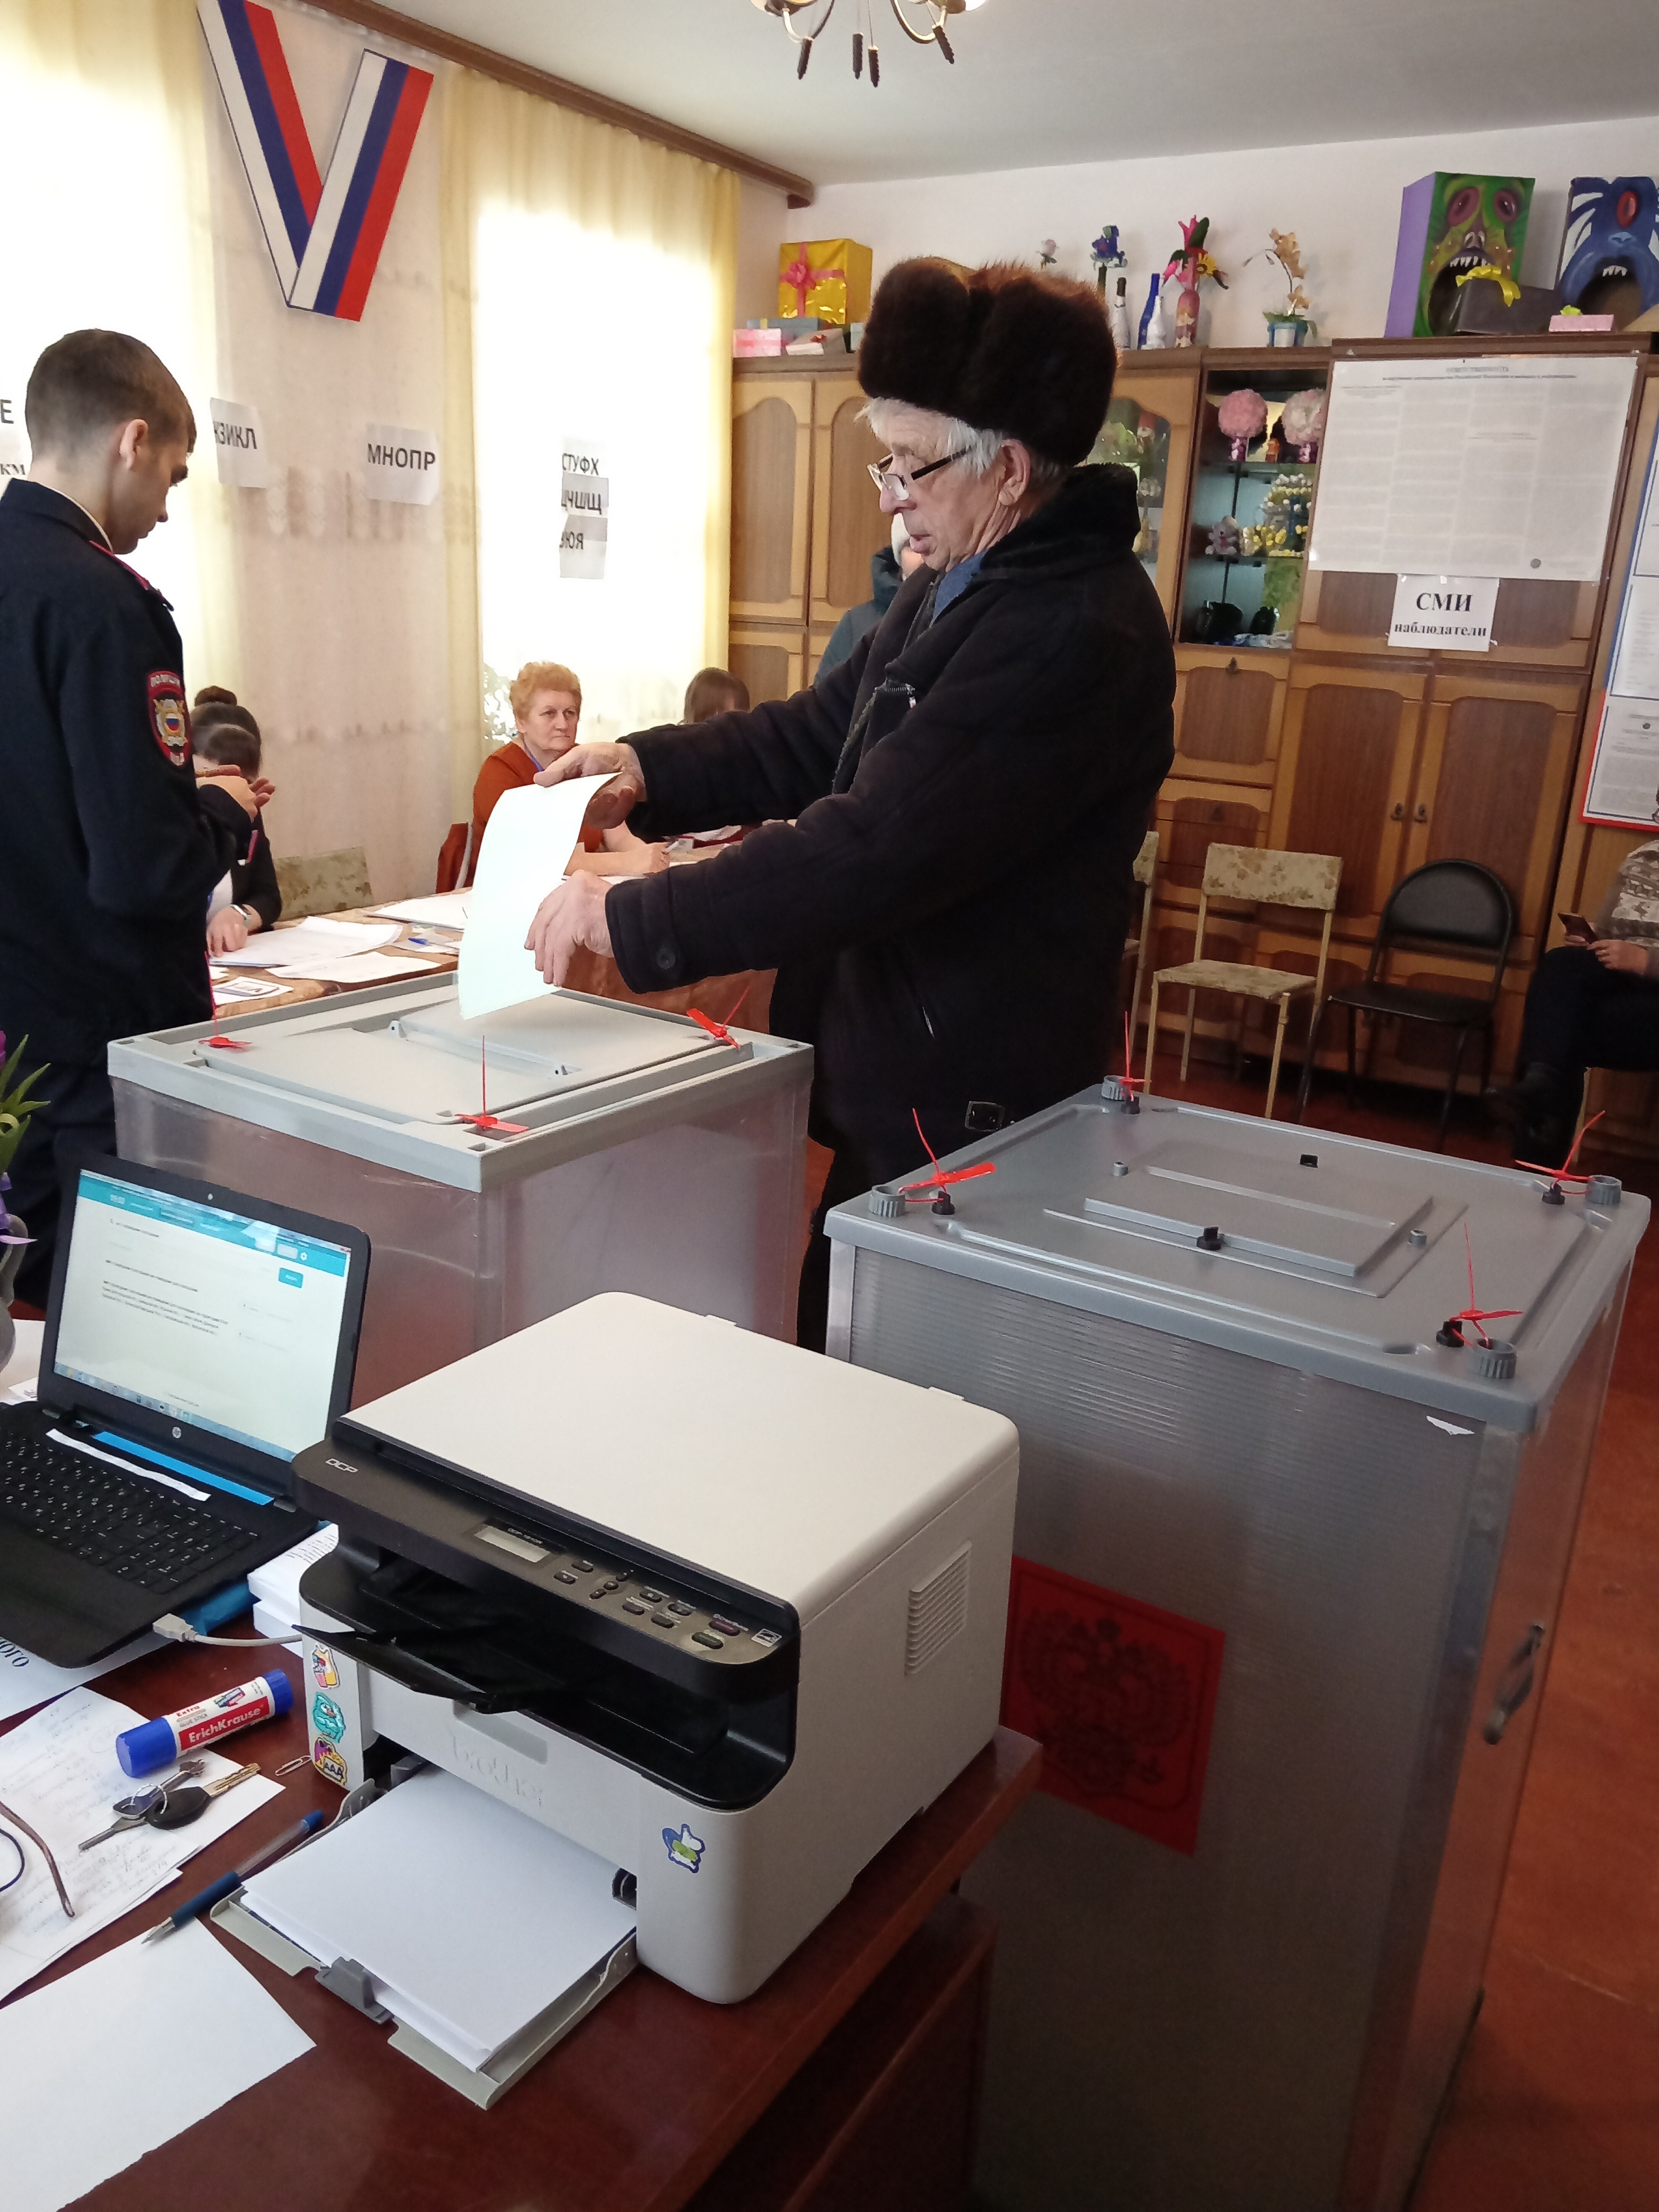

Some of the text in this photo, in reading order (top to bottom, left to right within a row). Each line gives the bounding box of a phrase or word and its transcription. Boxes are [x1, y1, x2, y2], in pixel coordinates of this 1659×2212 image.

[367, 443, 436, 471] МНОПР
[1416, 593, 1473, 612] СМИ
[1394, 622, 1486, 637] наблюдатели
[325, 1458, 359, 1473] DCP
[176, 1706, 201, 1717] Extra
[188, 1708, 261, 1743] ErichKrause
